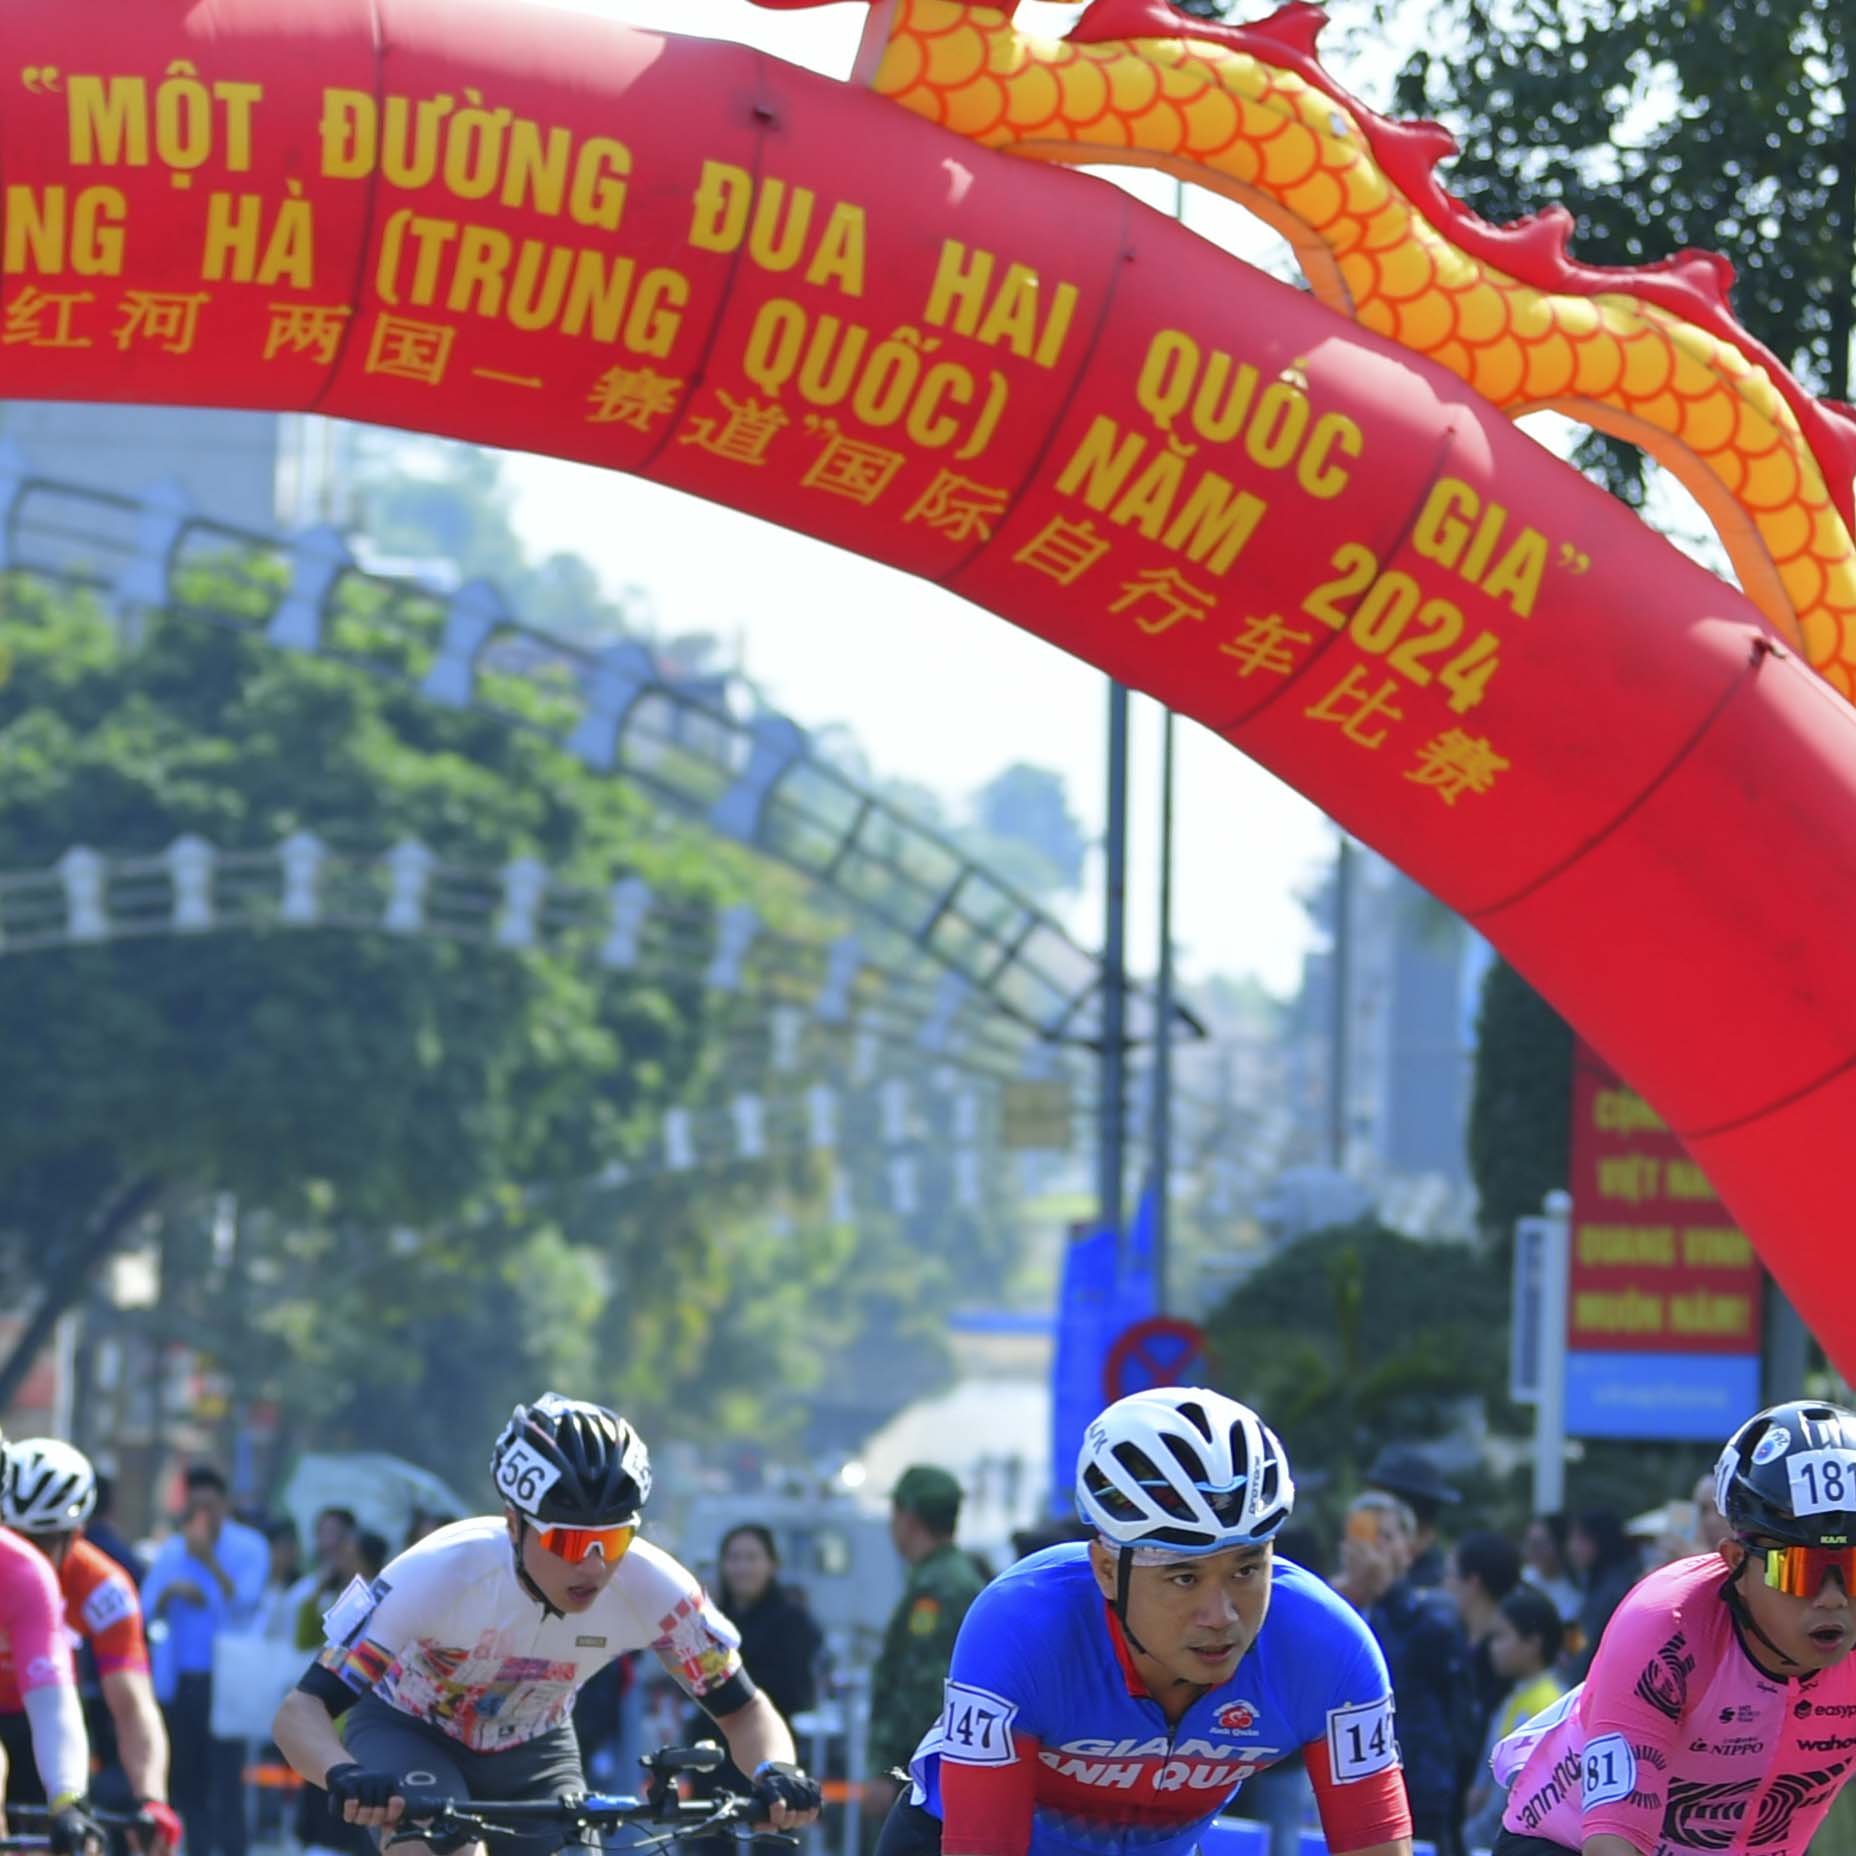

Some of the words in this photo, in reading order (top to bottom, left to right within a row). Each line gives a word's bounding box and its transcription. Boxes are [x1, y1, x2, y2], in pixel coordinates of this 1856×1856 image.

[319, 87, 632, 231] ĐƯỜNG
[689, 160, 866, 296] ĐUA
[925, 239, 1078, 368] HAI
[1137, 329, 1363, 499] QUỐC
[203, 180, 312, 288] HÀ
[375, 209, 690, 358] (TRUNG
[745, 299, 1008, 458] QUỐC)
[1057, 415, 1266, 574] NĂM
[1303, 543, 1501, 713] 2024
[501, 1449, 545, 1501] 56
[944, 1700, 995, 1750] 147
[1060, 1736, 1281, 1759] GIANT
[1710, 1741, 1764, 1756] NIPPO
[1584, 1750, 1619, 1793] 81
